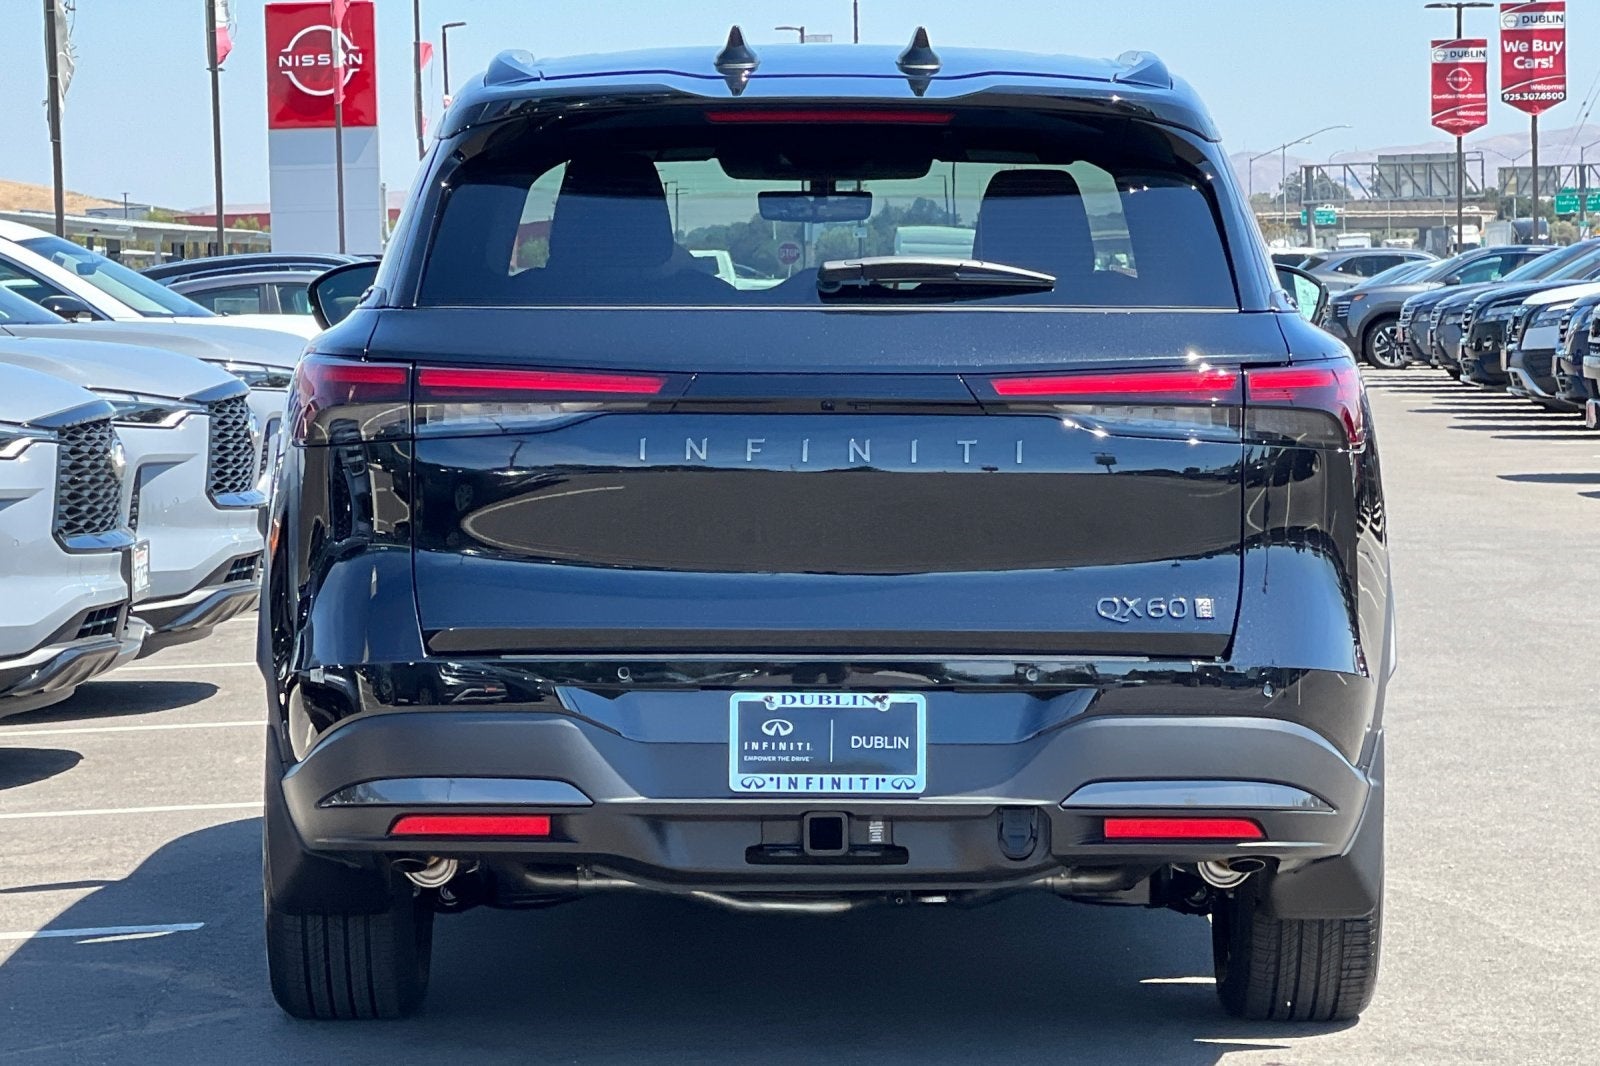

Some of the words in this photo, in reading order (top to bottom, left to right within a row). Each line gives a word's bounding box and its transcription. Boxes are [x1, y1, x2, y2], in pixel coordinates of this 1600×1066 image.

[1521, 14, 1564, 24] DUBLIN
[1503, 40, 1529, 53] We
[1532, 39, 1564, 55] Buy
[1449, 50, 1486, 58] DUBLIN
[1513, 56, 1554, 69] Cars!
[1503, 92, 1565, 101] 925.307.6500
[639, 437, 1023, 463] INFINITI
[1096, 596, 1189, 623] QX60
[744, 741, 811, 751] INFINITI
[851, 735, 910, 749] DUBLIN
[776, 776, 880, 790] INFINITI
